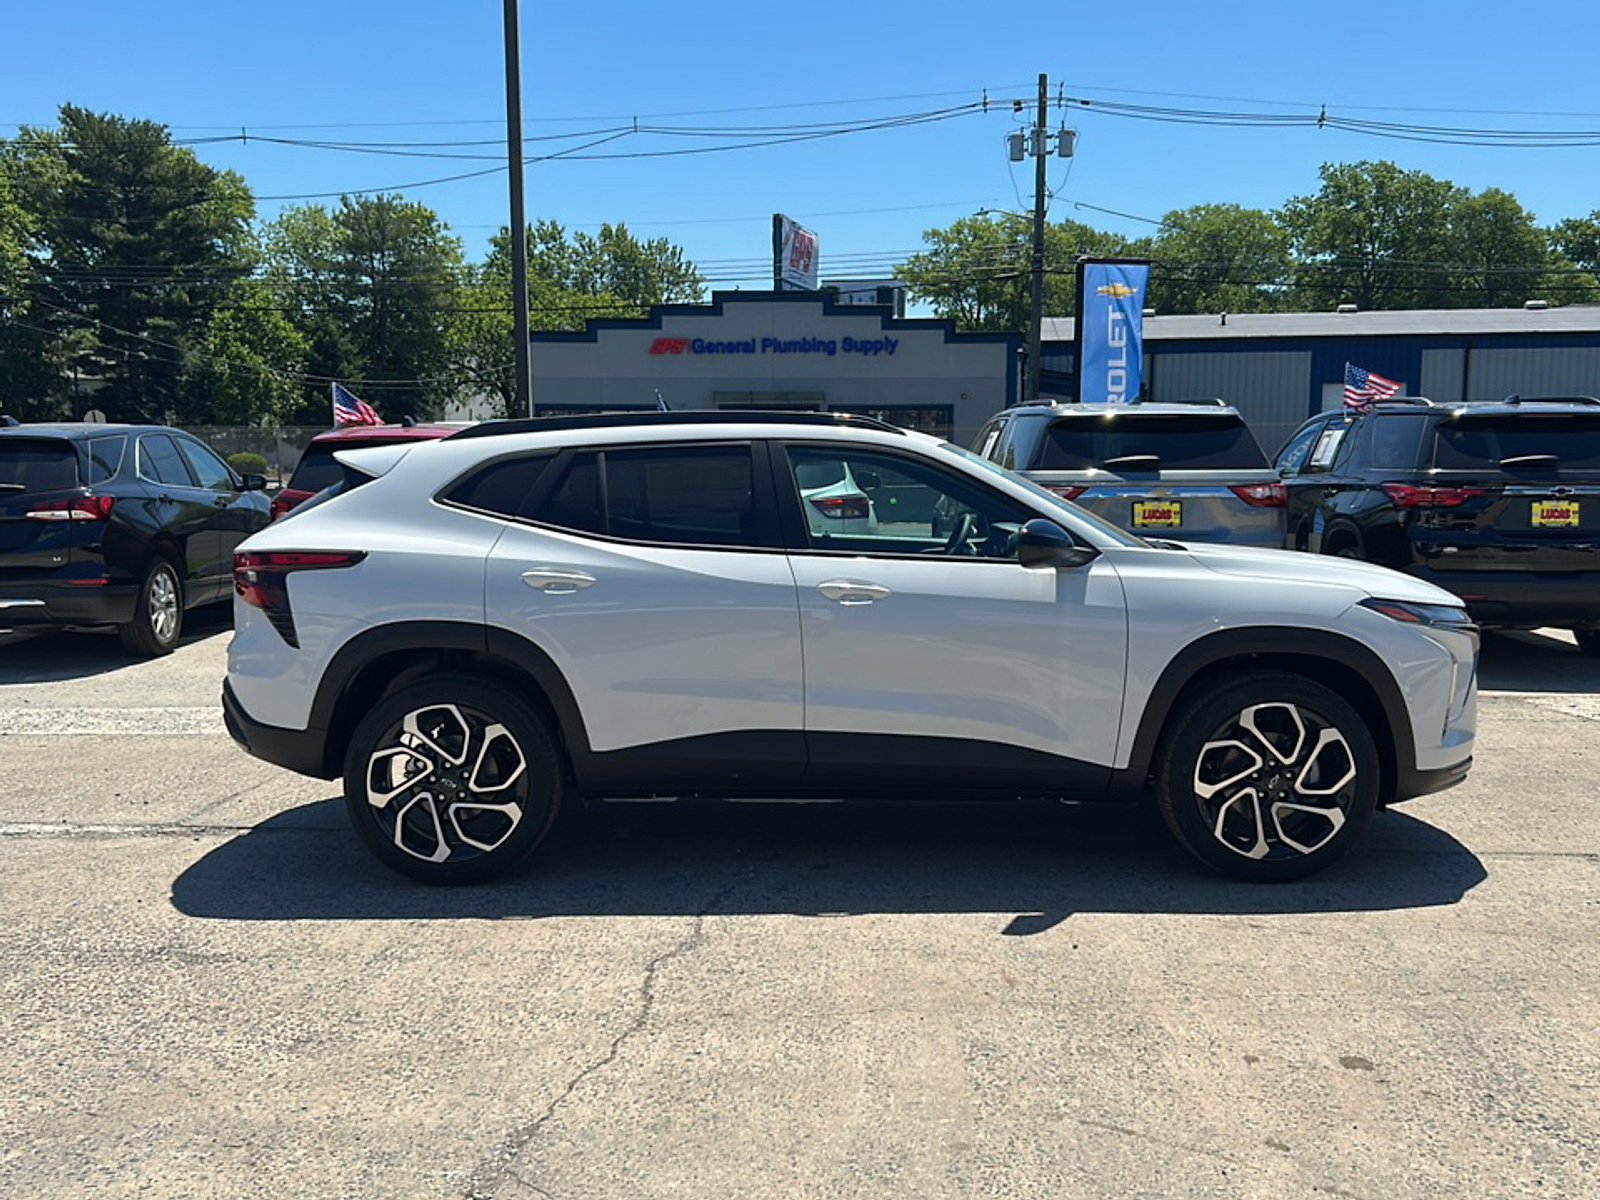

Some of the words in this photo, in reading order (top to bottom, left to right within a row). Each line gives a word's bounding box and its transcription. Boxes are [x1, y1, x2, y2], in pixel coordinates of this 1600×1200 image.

[691, 338, 756, 355] General
[761, 337, 837, 356] Plumbing
[841, 336, 899, 355] Supply
[1539, 508, 1572, 520] LUCAS
